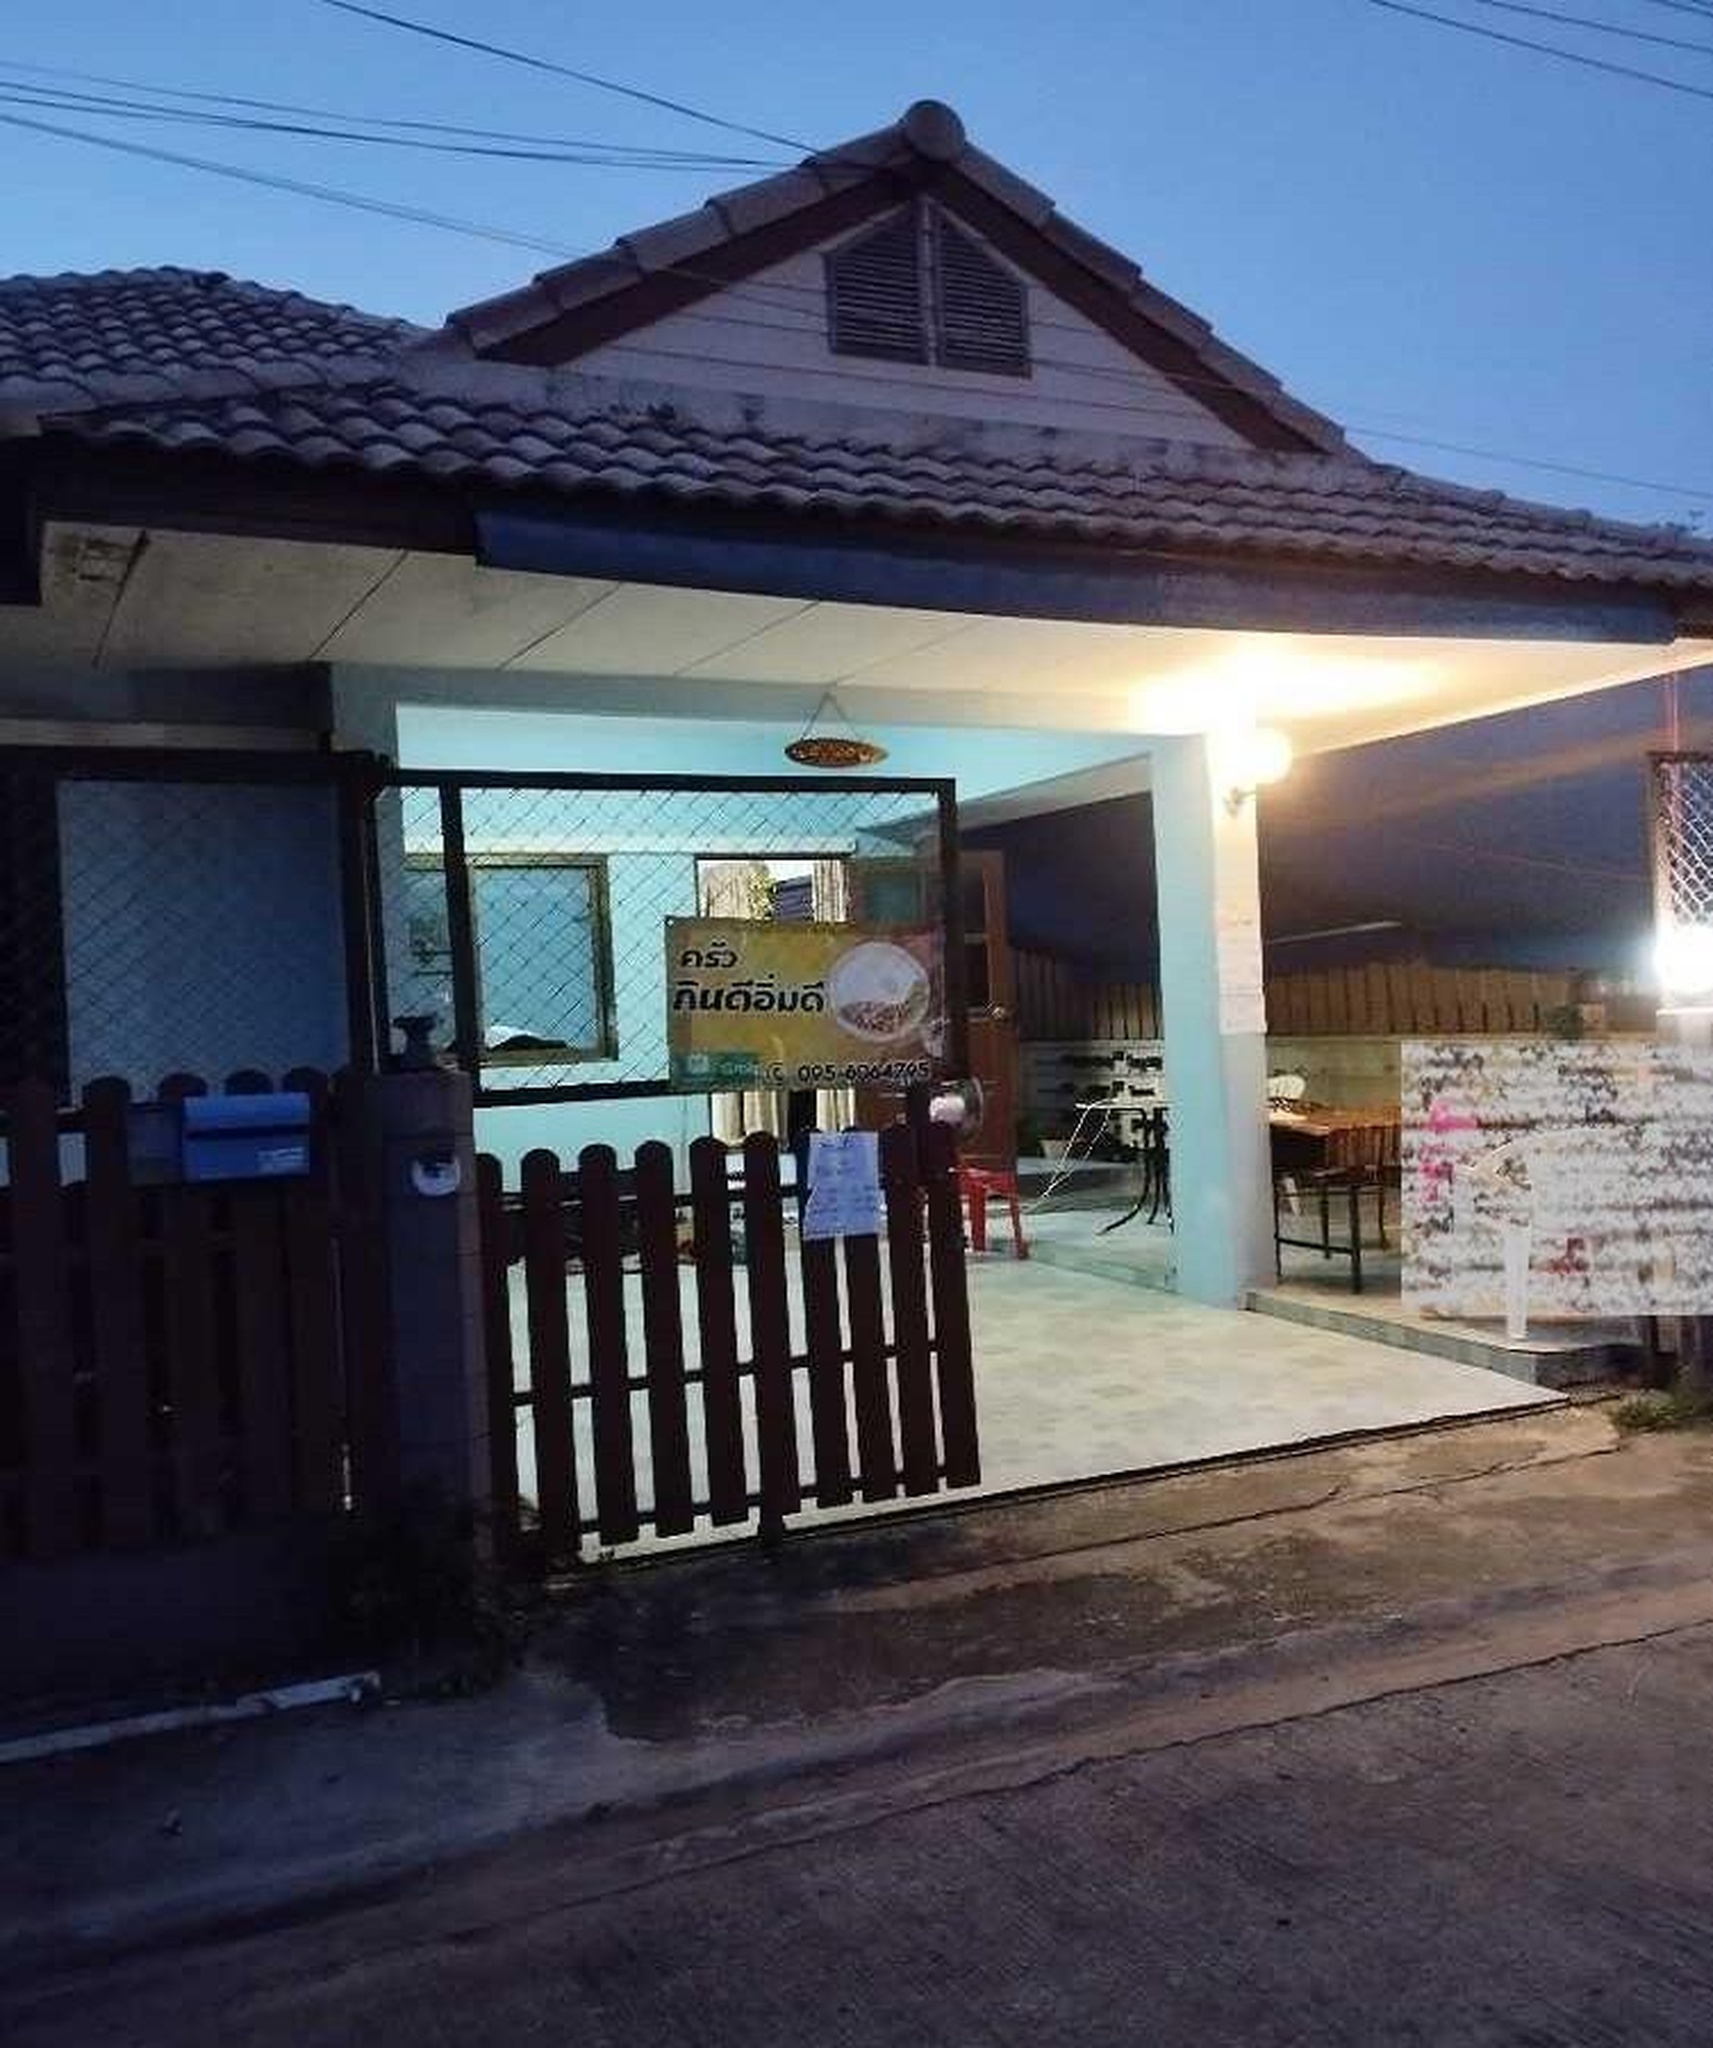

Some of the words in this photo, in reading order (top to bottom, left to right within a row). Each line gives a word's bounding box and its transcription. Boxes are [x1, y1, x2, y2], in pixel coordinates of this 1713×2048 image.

[681, 940, 738, 968] ครัว
[673, 973, 824, 1012] กินดีอิ่มดี
